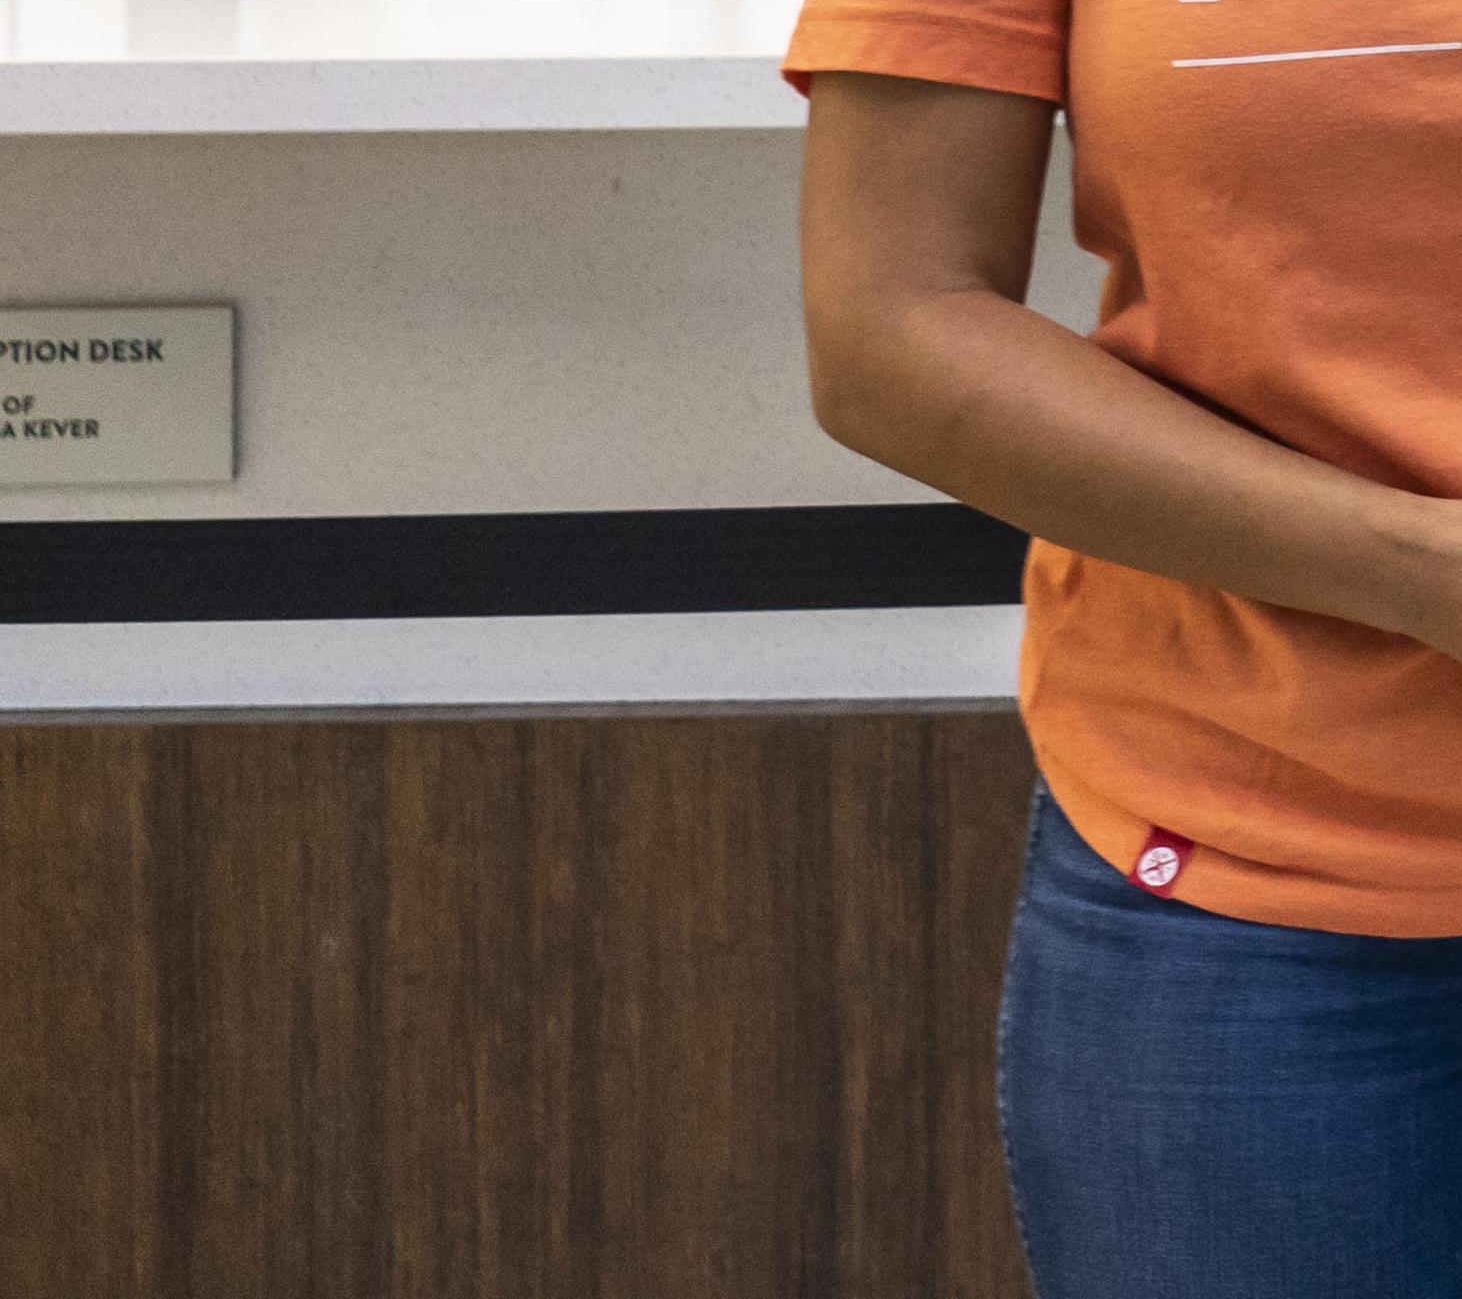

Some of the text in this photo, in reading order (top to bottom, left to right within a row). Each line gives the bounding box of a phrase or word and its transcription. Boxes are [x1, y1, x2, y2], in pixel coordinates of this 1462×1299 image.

[88, 339, 163, 363] DESK
[2, 395, 35, 415] OF
[23, 419, 99, 439] KEVER
